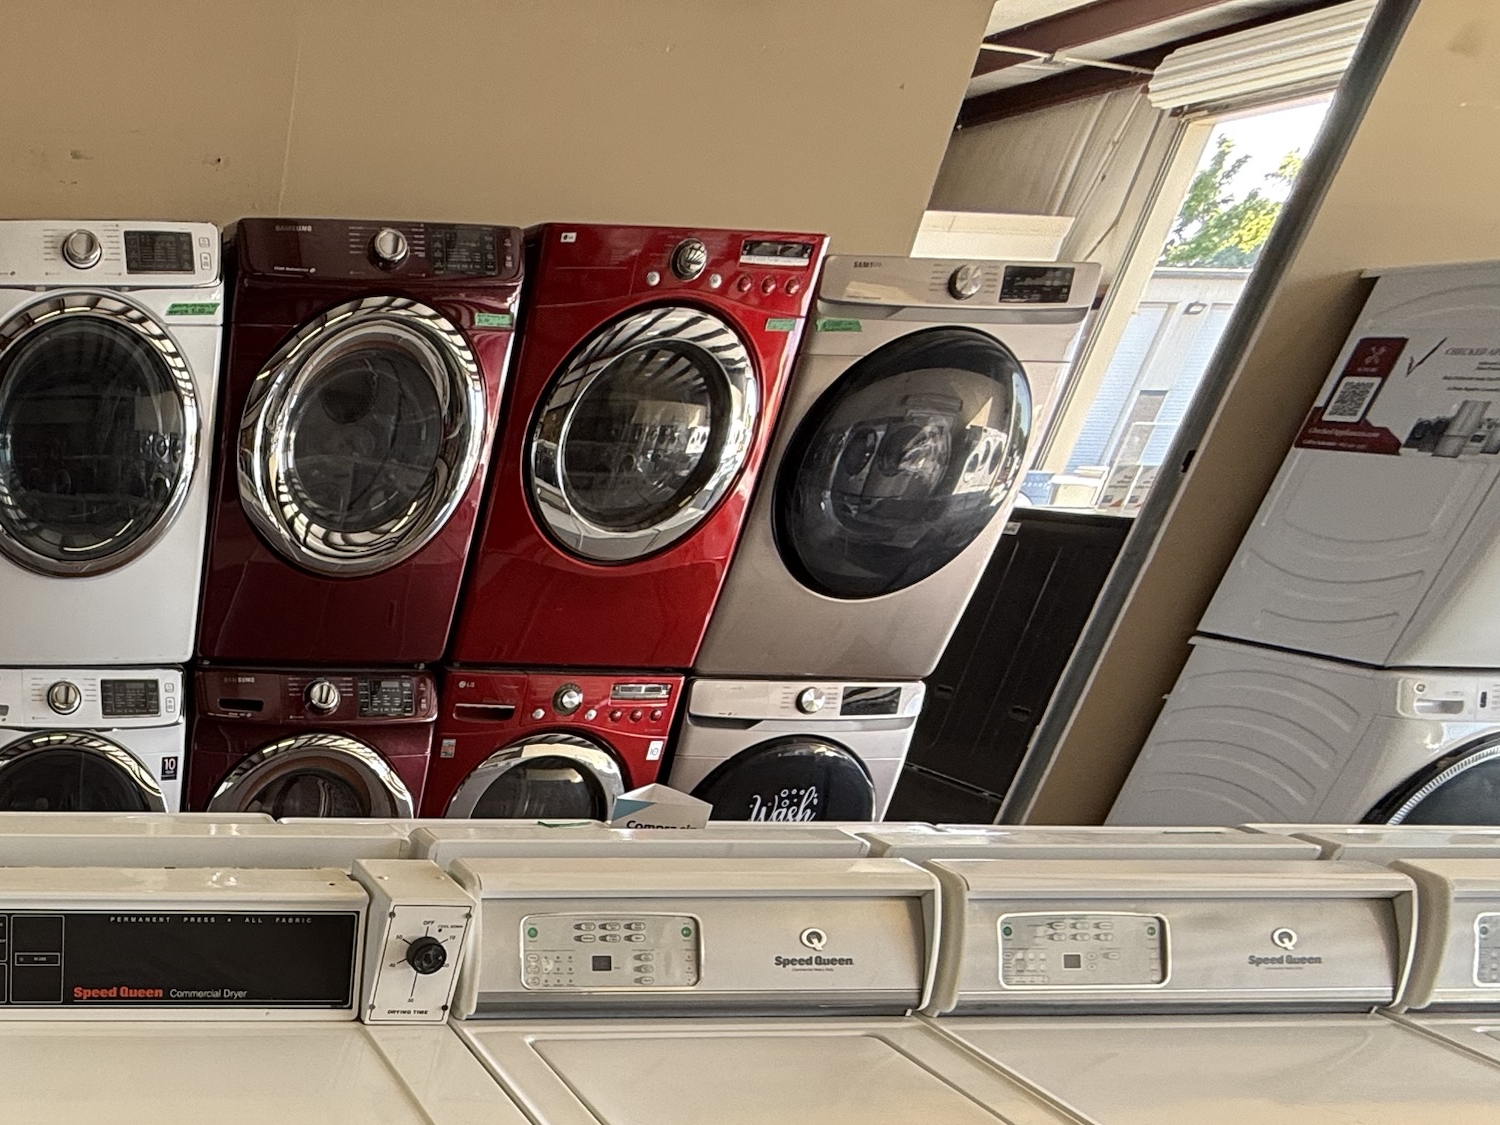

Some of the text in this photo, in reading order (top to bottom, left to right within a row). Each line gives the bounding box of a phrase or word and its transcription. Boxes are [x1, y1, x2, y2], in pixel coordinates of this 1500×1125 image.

[164, 758, 176, 770] 10
[751, 786, 817, 822] Wash
[774, 955, 854, 968] Speed Queen
[1248, 955, 1322, 967] Speed Queen
[73, 986, 248, 1000] Speed Queen Commercial Dryer
